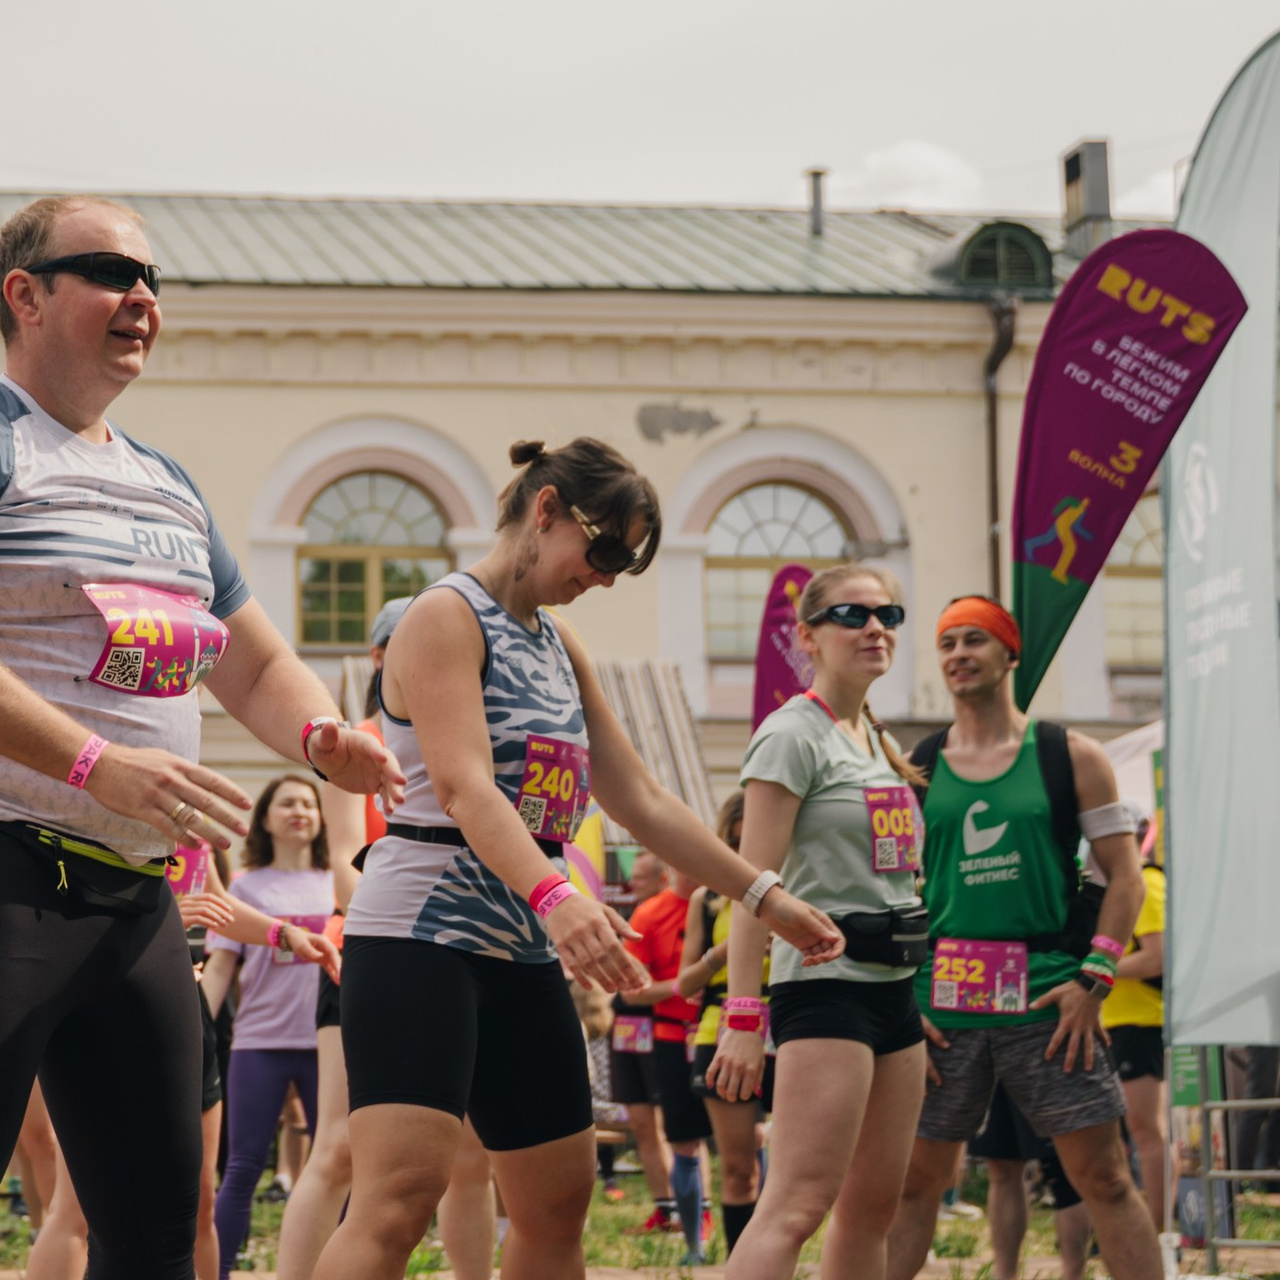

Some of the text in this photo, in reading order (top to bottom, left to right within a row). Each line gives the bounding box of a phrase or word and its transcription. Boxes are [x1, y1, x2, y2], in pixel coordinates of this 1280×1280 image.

[1097, 263, 1216, 345] RUTS
[1091, 338, 1107, 356] В
[1119, 334, 1191, 383] БЕЖИМ
[1063, 361, 1164, 424] ПО ГОРОДУ
[1111, 369, 1174, 412] ТЕМПЕ
[1068, 449, 1126, 490] ВОЛНА
[1110, 441, 1143, 474] 3
[130, 527, 199, 565] RUN
[93, 591, 126, 599] RUTS
[107, 608, 174, 646] 241
[531, 741, 554, 754] RUTS
[522, 761, 574, 802] 240
[872, 808, 913, 837] 003
[964, 867, 1019, 886] ФИТНЕС
[934, 956, 985, 983] 252
